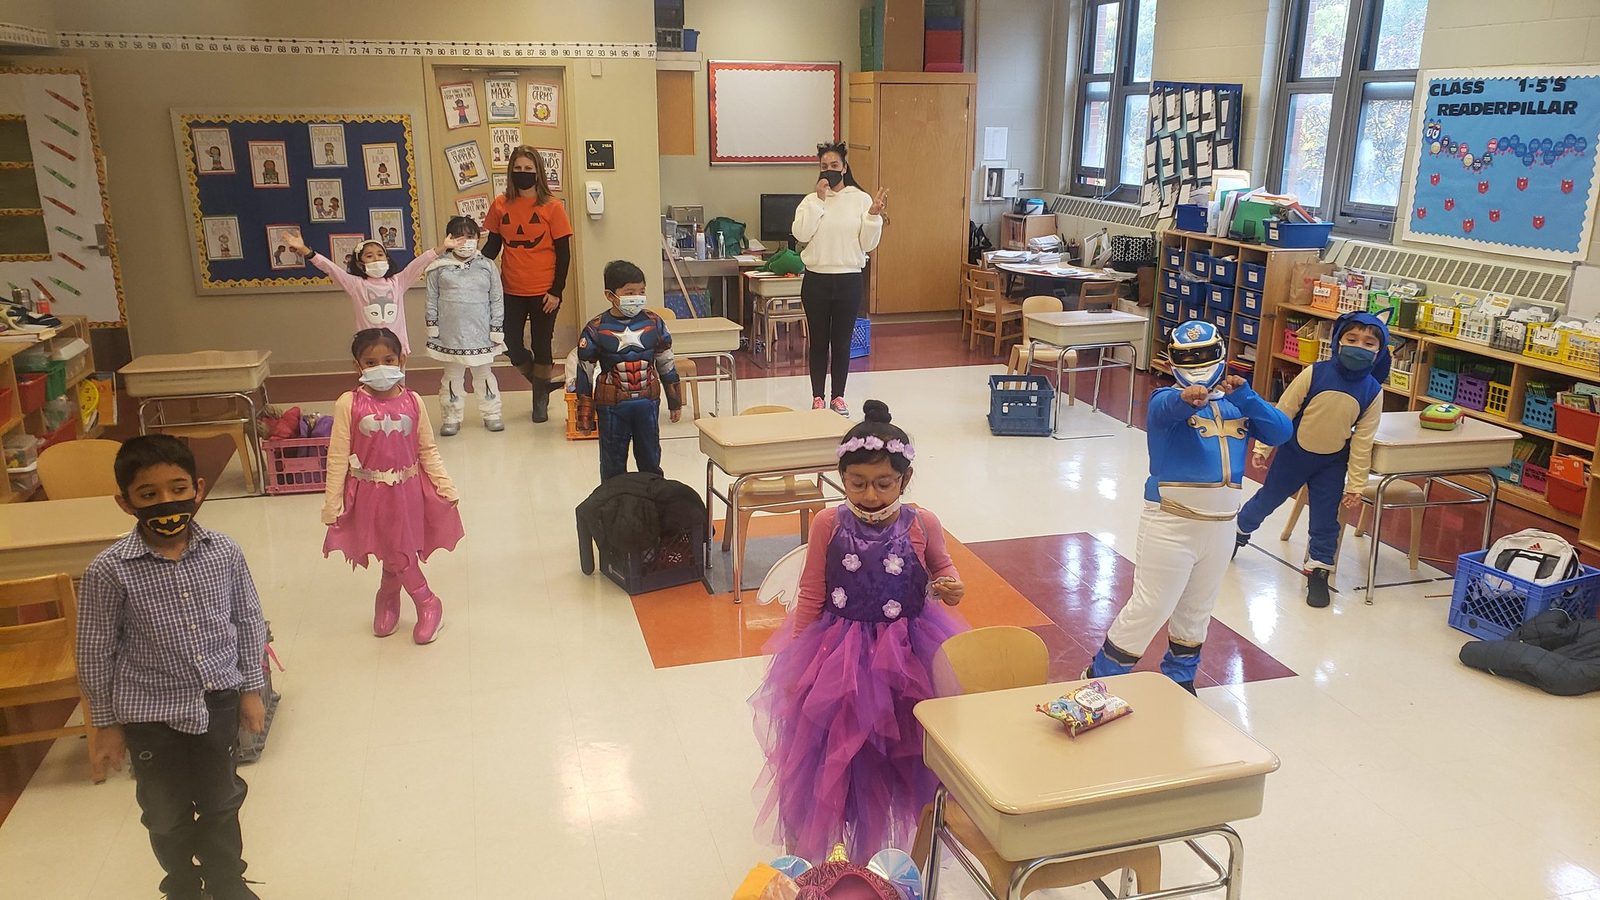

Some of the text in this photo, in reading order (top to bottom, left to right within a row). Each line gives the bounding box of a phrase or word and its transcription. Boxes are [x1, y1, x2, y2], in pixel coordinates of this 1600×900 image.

[491, 88, 513, 99] MASK
[1430, 80, 1485, 96] CLASS
[532, 90, 553, 101] GERMS
[1437, 100, 1578, 116] READERPILLAR
[494, 134, 519, 143] TOGETHER
[1501, 323, 1513, 331] Level
[1535, 332, 1549, 340] Level
